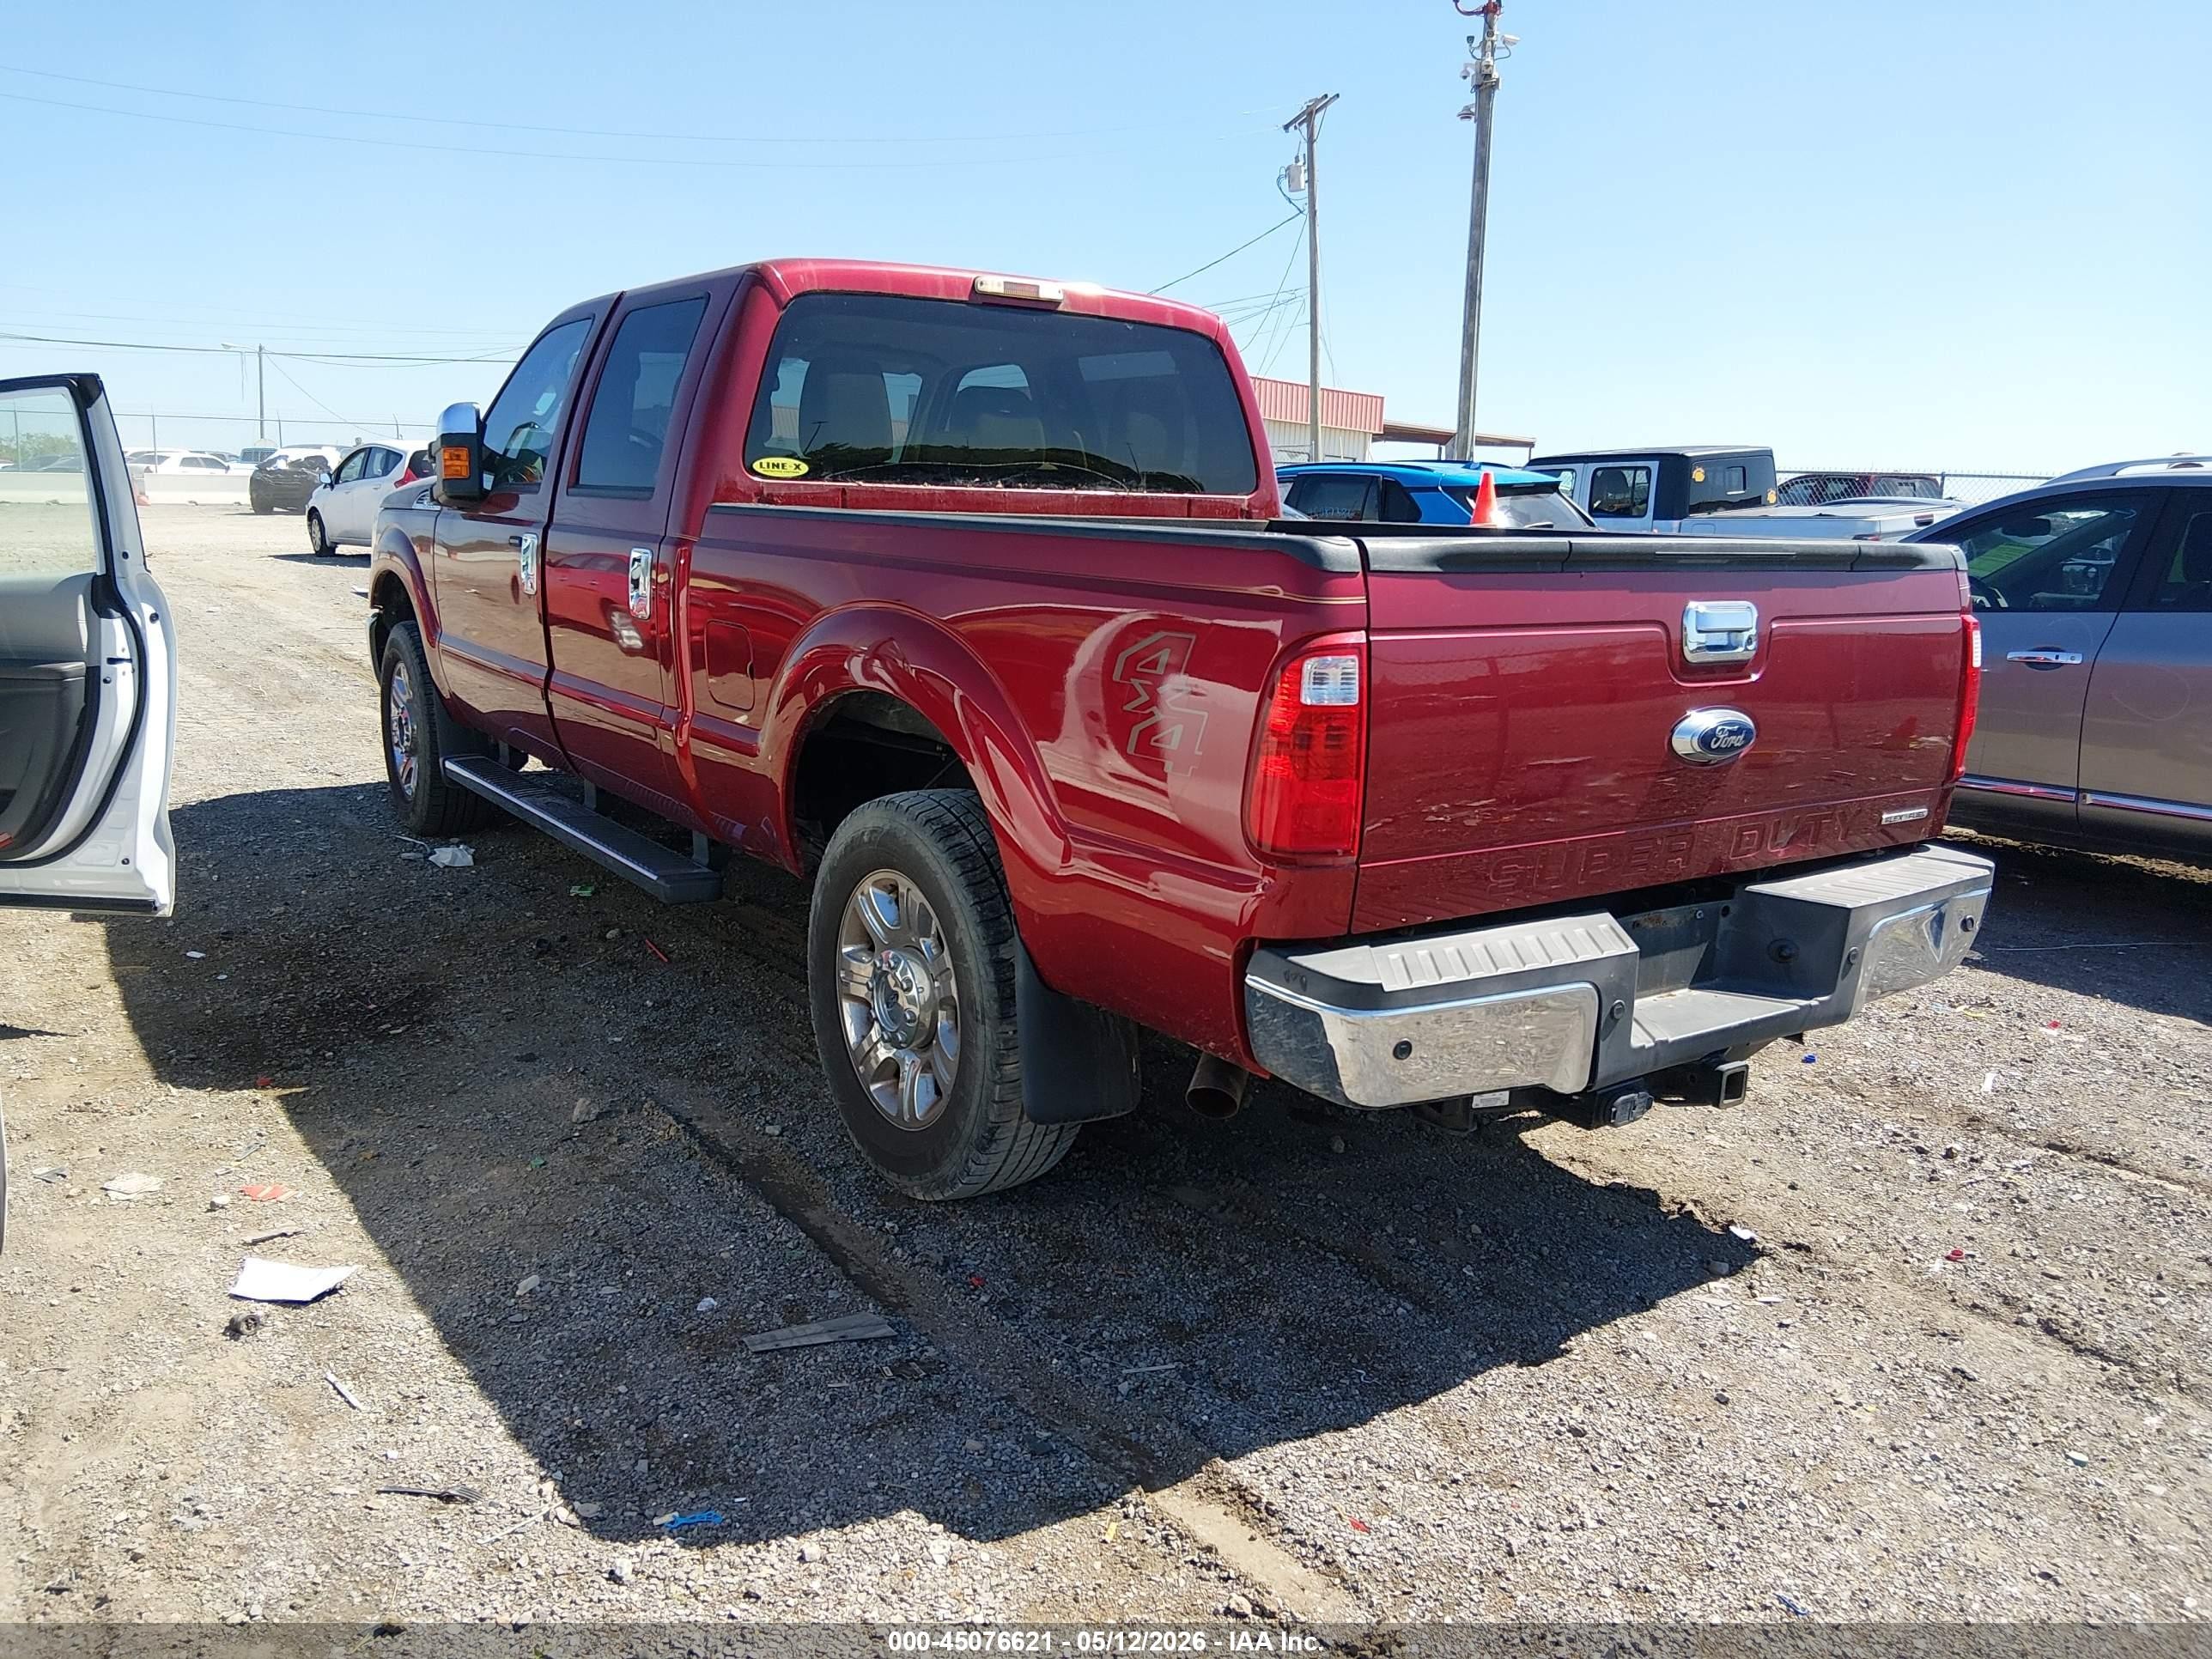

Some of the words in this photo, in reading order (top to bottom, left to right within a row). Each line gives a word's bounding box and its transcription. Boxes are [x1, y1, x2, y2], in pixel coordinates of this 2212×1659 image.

[759, 461, 802, 471] LINE-X
[1710, 726, 1747, 750] Ford
[1488, 832, 1698, 896] SUPER
[1730, 808, 1862, 860] DUTY
